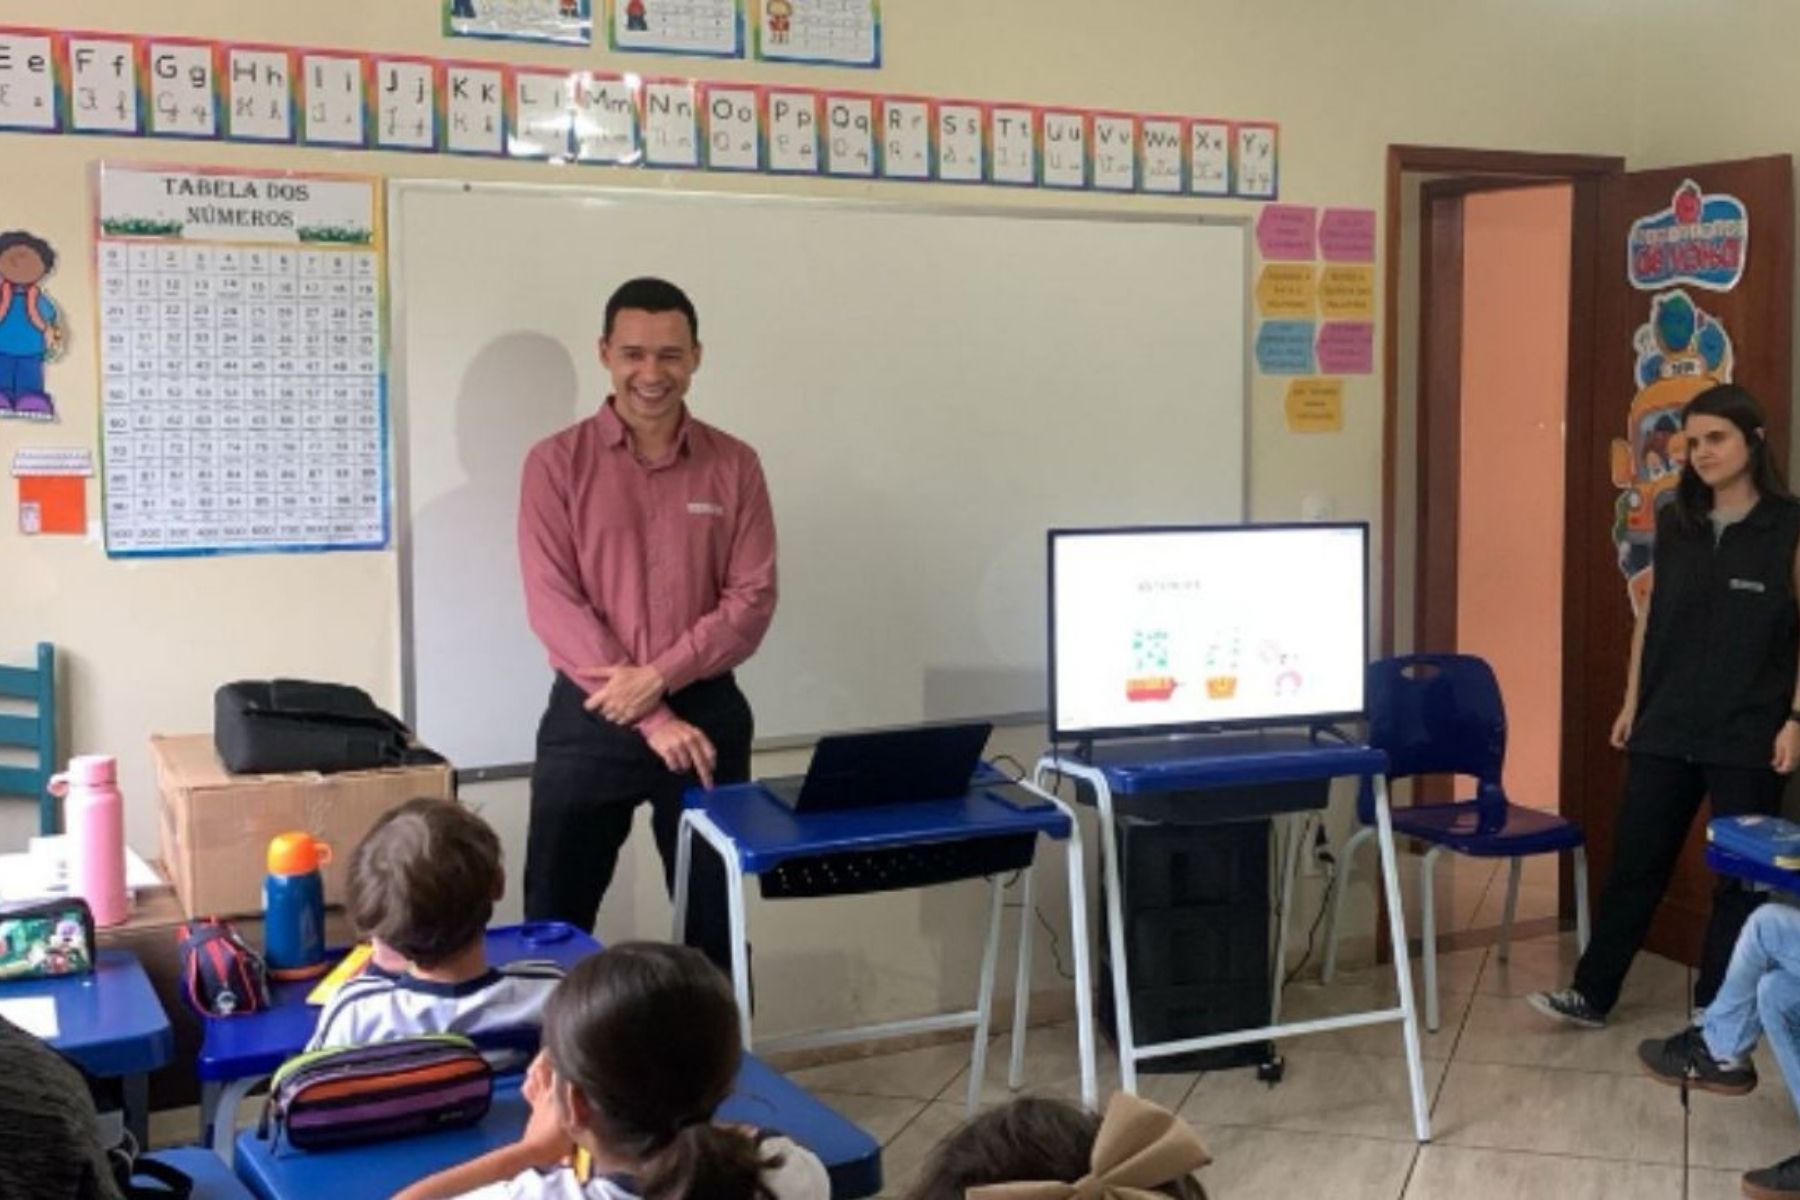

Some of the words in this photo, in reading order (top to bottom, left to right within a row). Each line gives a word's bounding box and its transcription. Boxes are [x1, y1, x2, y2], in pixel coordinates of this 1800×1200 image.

[162, 178, 258, 200] TABELA
[267, 184, 310, 200] DOS
[186, 204, 294, 228] NÚMEROS
